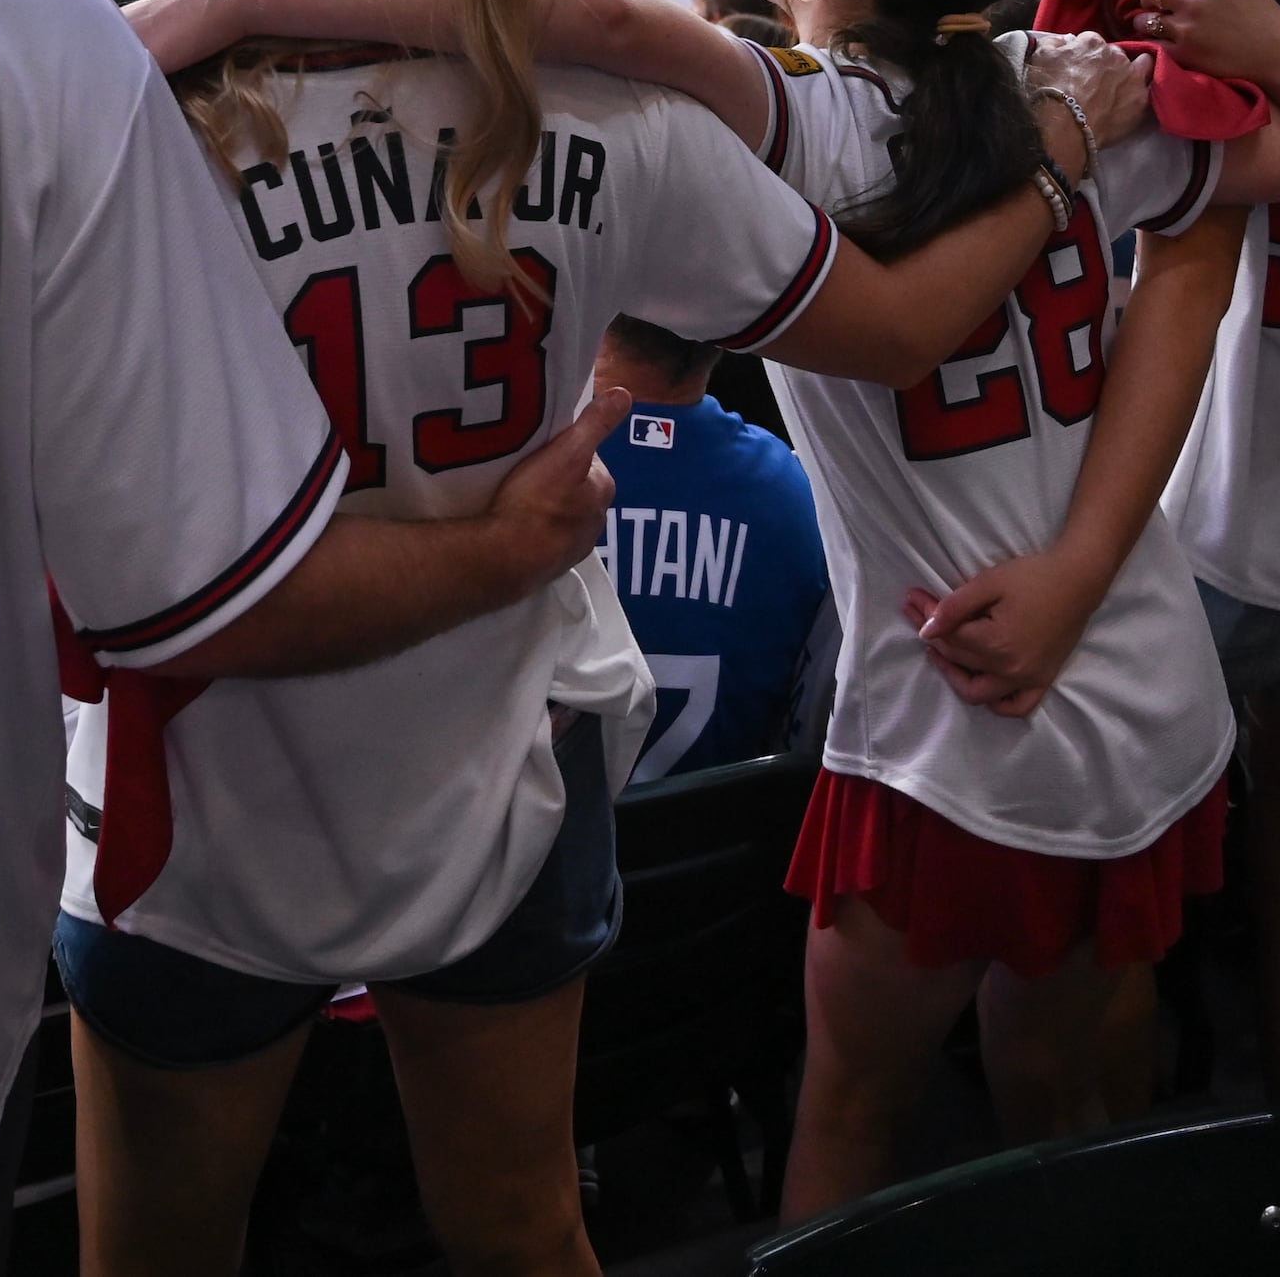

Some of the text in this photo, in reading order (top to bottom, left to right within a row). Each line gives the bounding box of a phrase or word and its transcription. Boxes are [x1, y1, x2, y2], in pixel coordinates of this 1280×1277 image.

[284, 245, 557, 493] 13
[894, 190, 1108, 462] 28
[627, 654, 720, 786] 7
